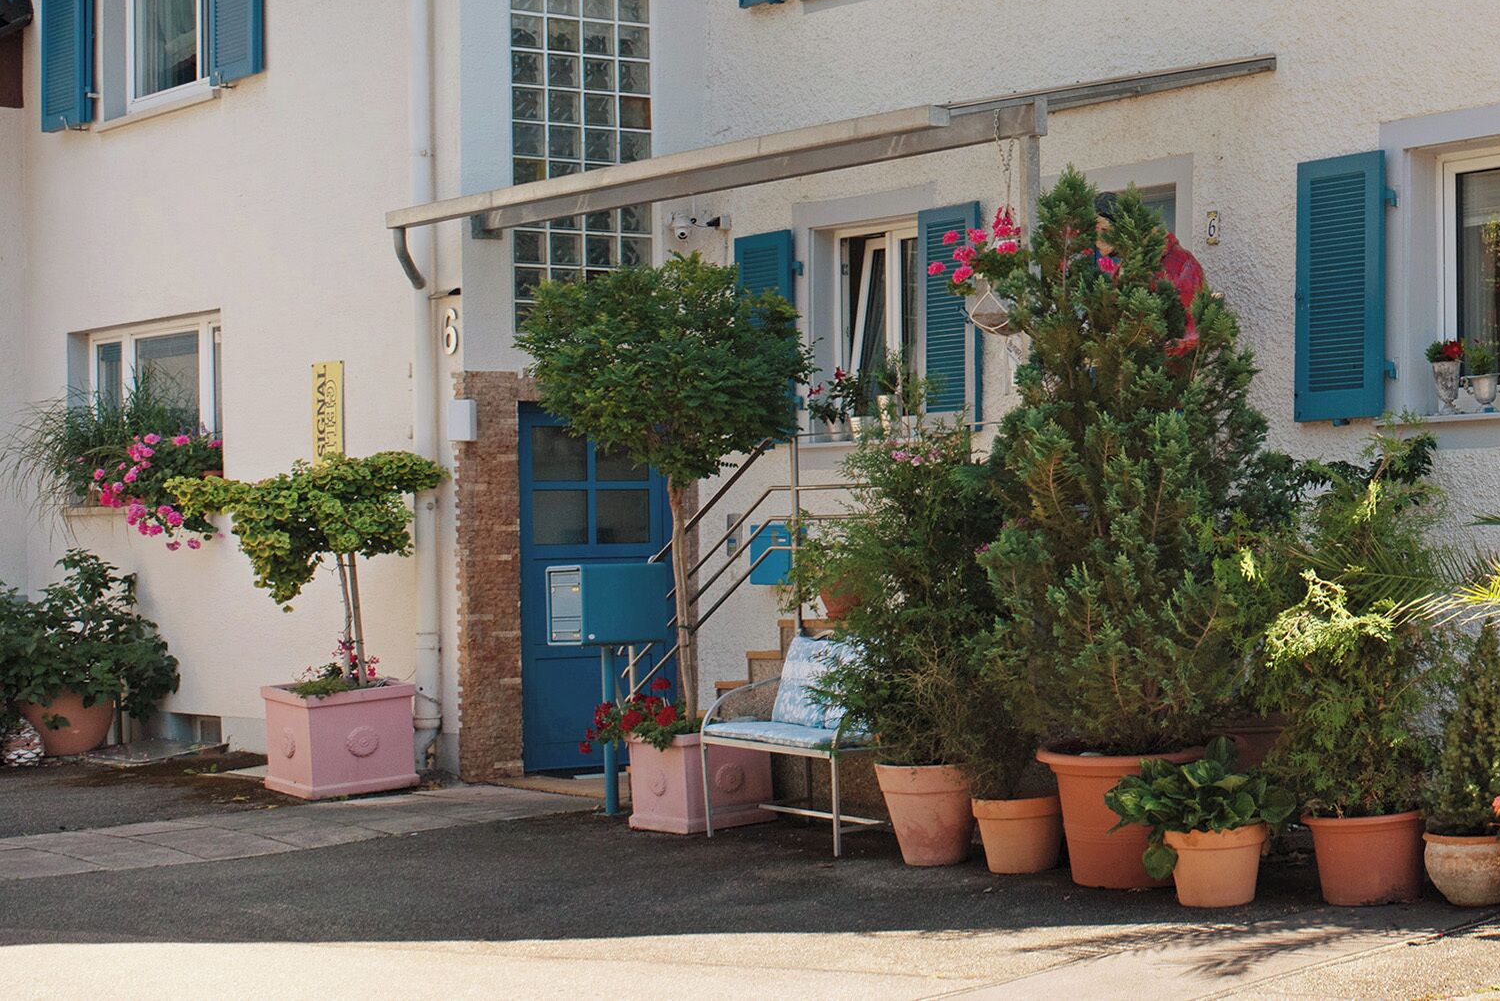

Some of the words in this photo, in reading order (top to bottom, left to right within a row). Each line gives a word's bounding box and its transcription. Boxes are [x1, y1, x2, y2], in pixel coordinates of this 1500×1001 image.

[1208, 218, 1216, 237] 6
[443, 308, 458, 355] 6
[317, 364, 326, 457] SIGNAL
